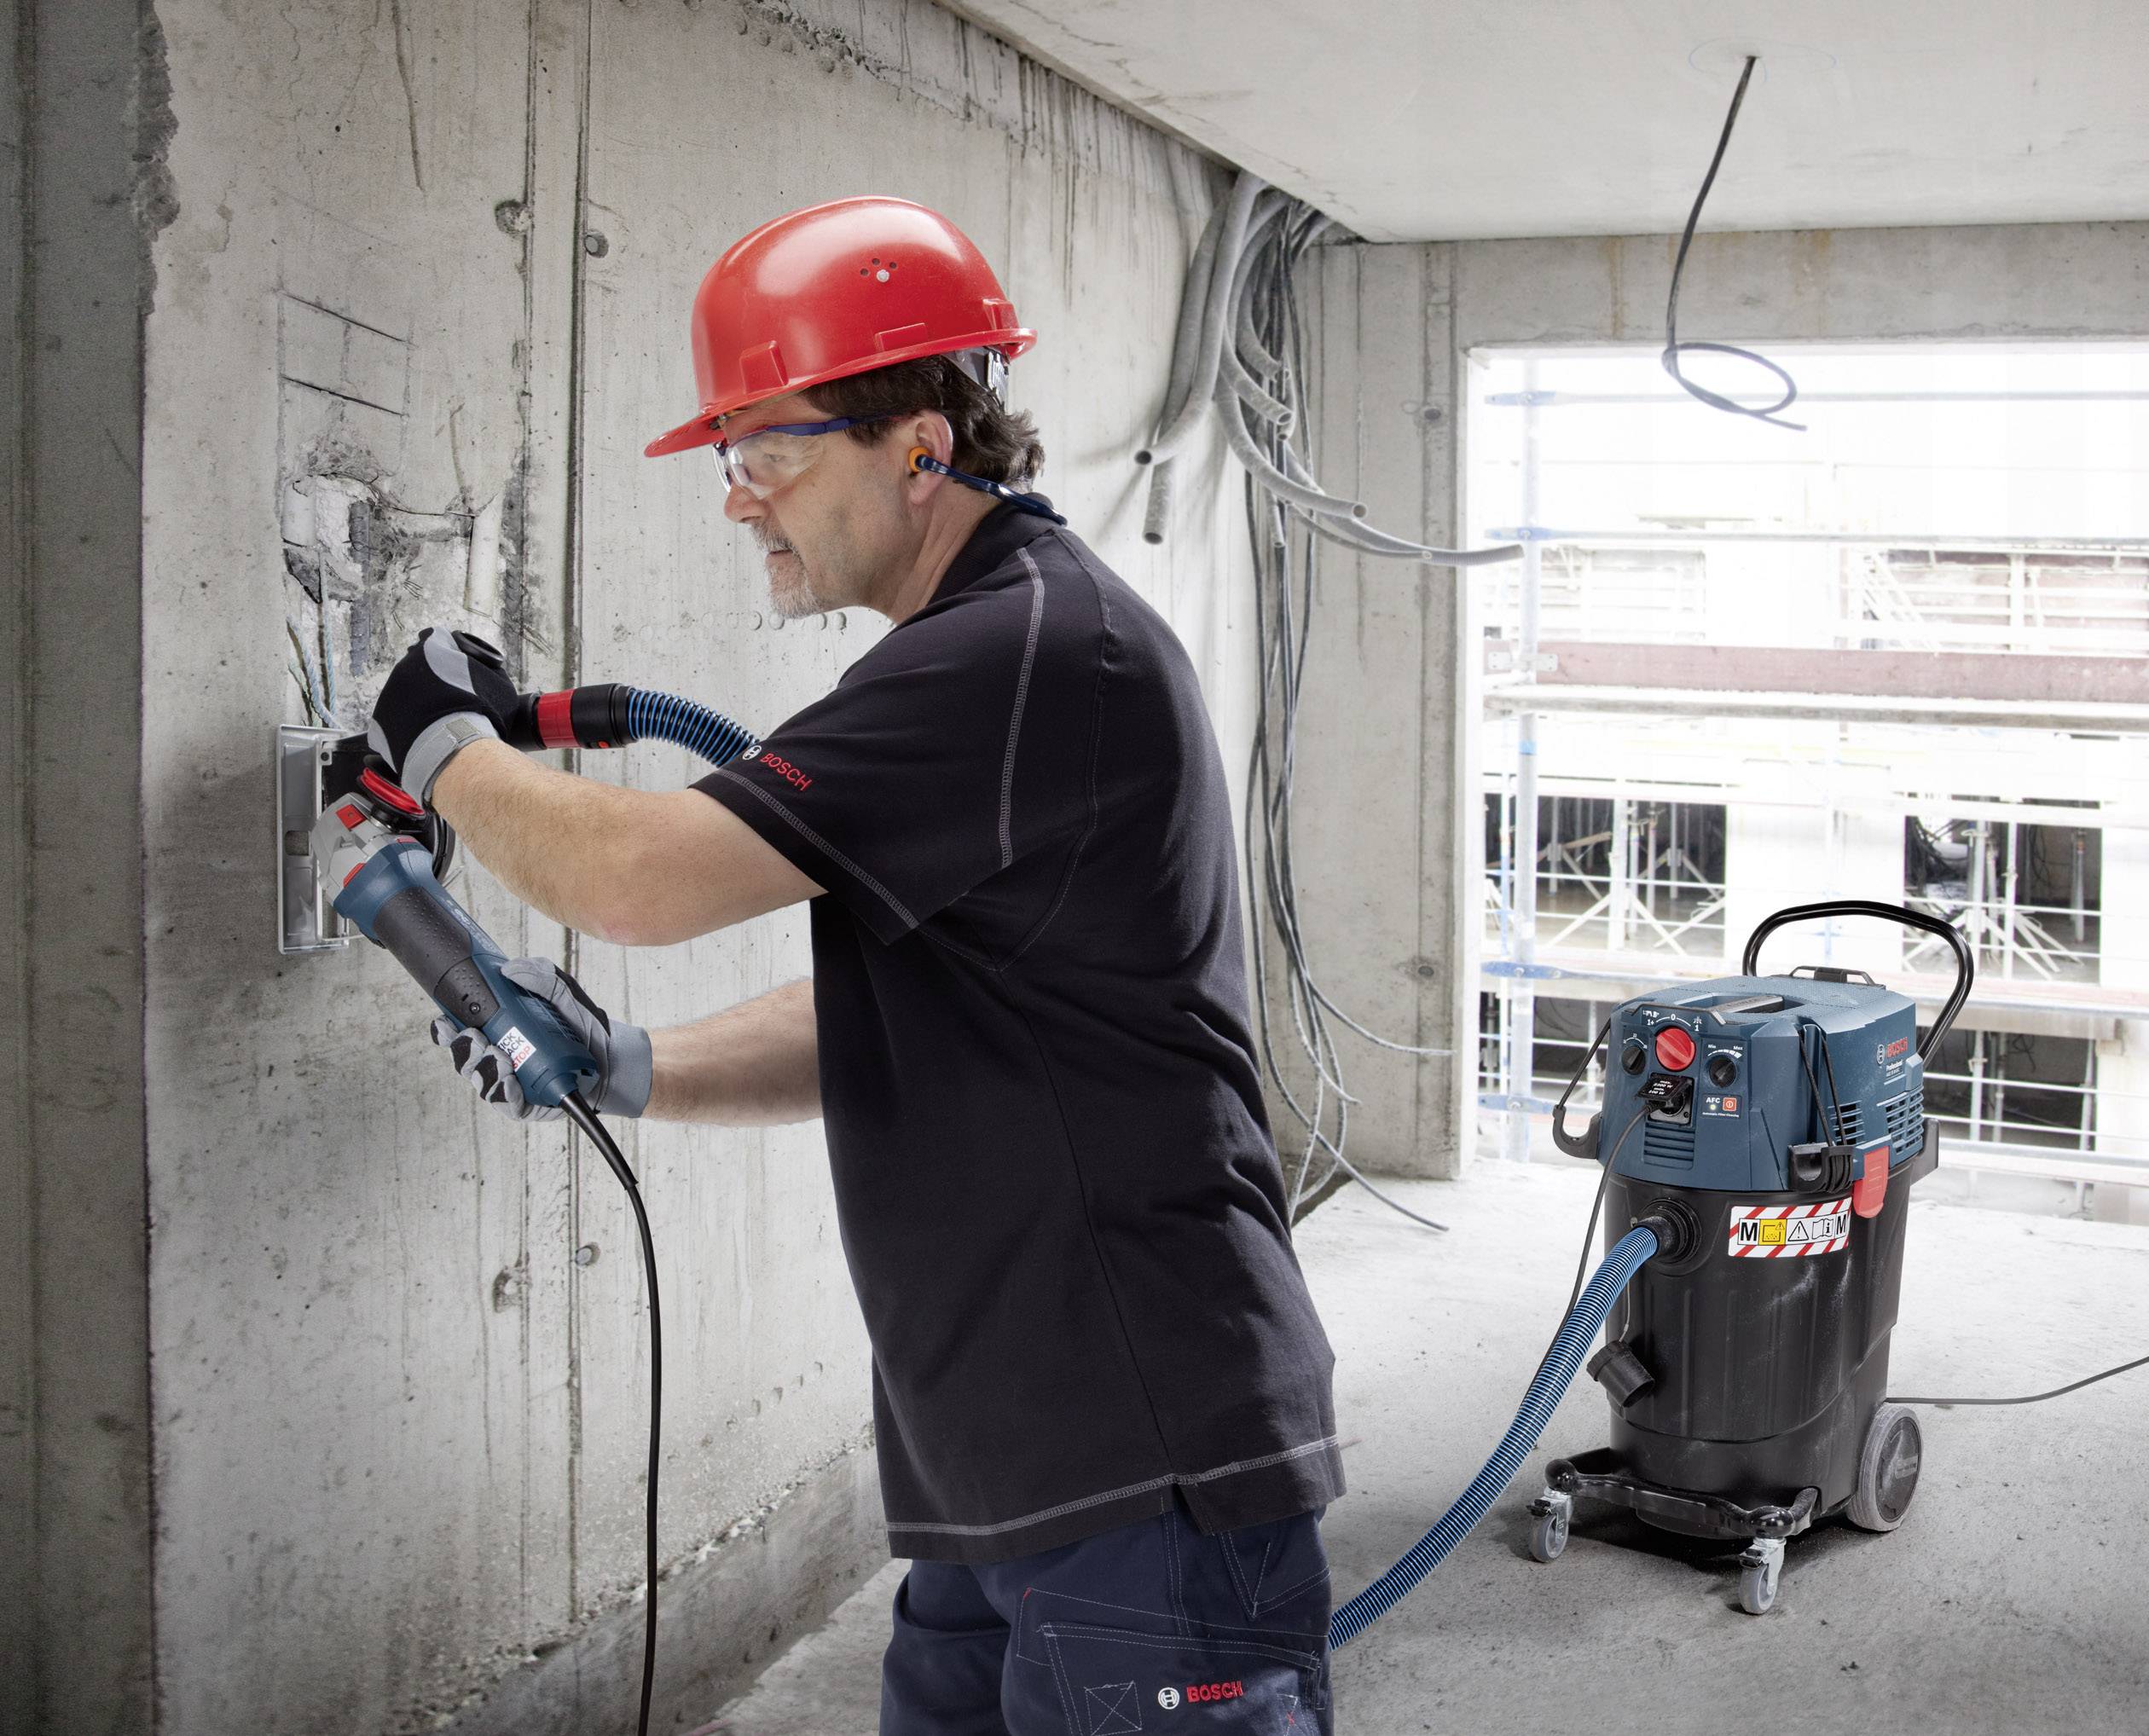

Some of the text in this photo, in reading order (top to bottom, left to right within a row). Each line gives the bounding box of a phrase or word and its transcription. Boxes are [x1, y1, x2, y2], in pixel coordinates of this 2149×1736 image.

[760, 753, 813, 790] BOSCH
[507, 1037, 524, 1056] ACK
[1886, 1036, 1909, 1058] BOSCH
[1740, 1213, 1847, 1241] M M
[1186, 1681, 1243, 1703] BOSCH
